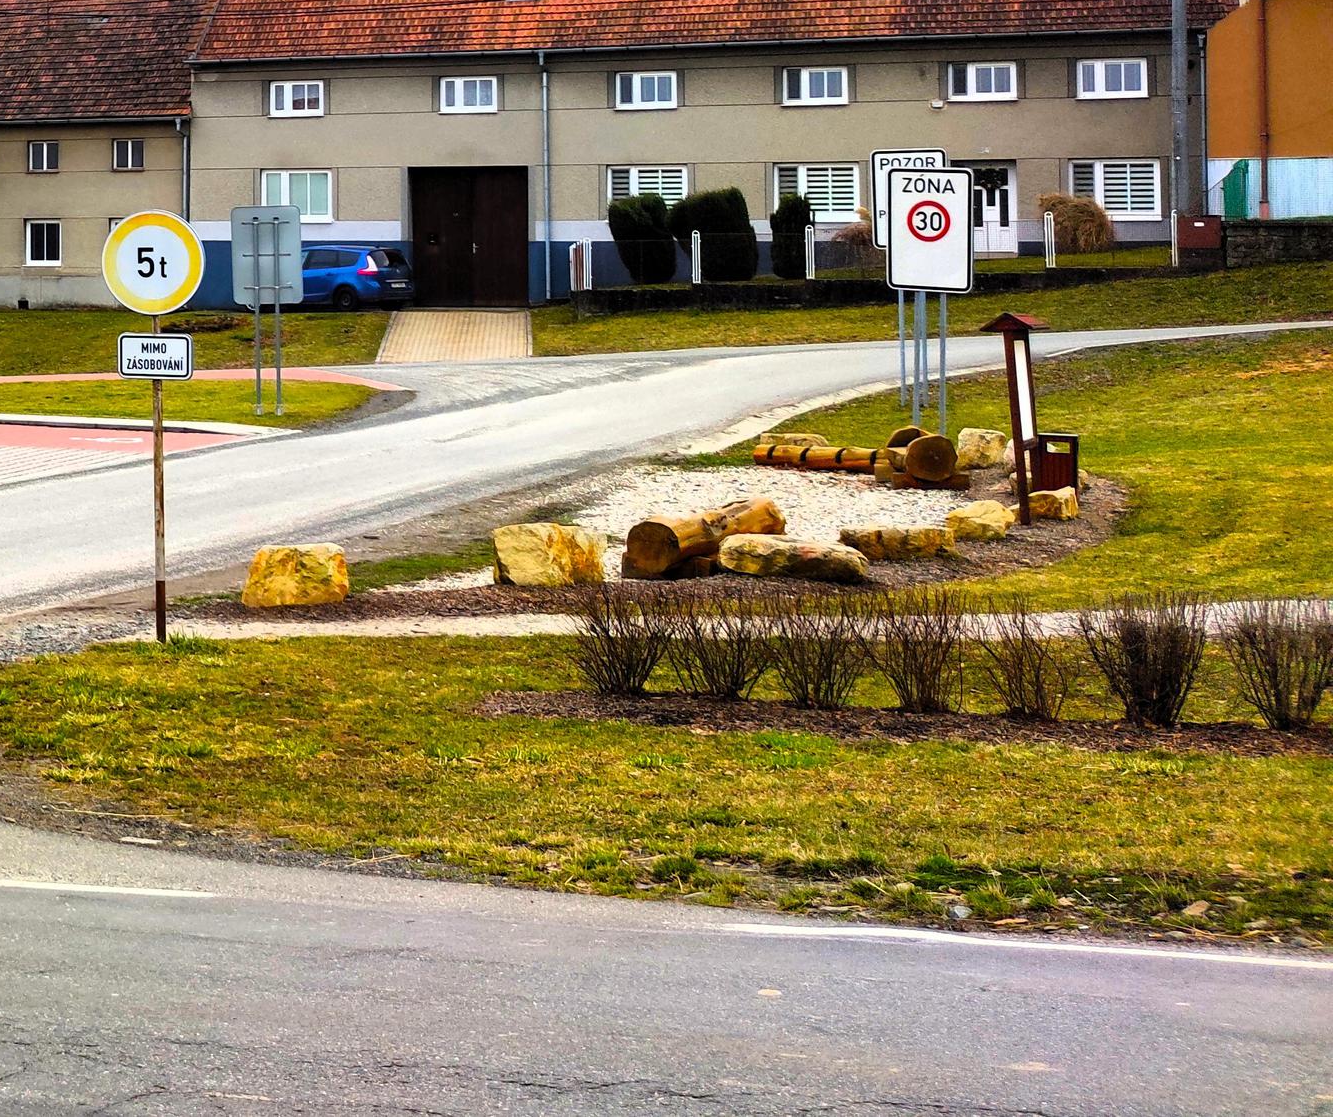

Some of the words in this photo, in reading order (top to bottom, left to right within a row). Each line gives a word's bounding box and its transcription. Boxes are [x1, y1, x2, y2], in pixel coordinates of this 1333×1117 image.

[879, 157, 936, 170] POZOR
[902, 174, 955, 194] ZÓNA
[915, 211, 942, 231] 30
[137, 247, 155, 278] 5
[159, 256, 168, 278] t
[141, 342, 167, 353] MIMO
[126, 355, 184, 371] ZÁSOBOVÁNÍ
